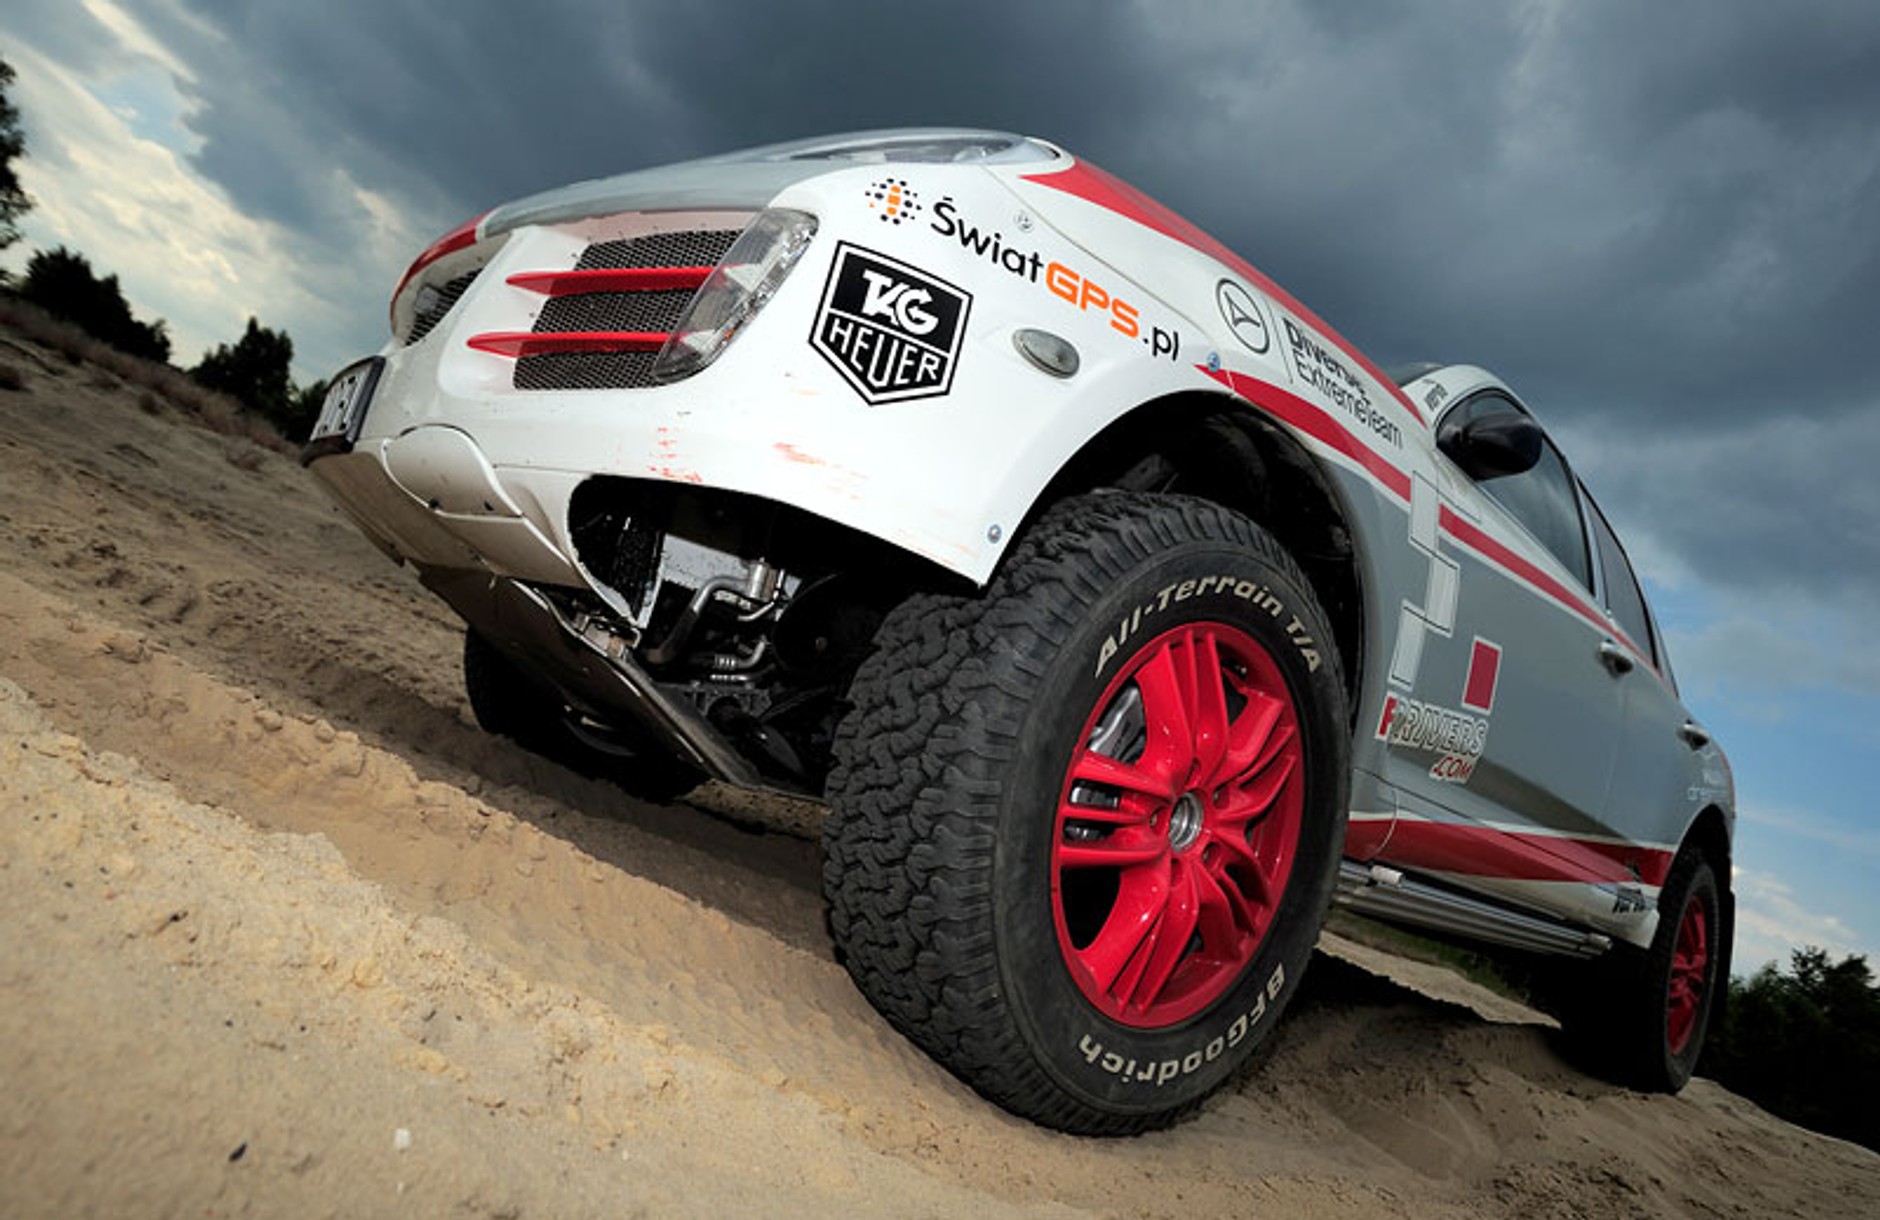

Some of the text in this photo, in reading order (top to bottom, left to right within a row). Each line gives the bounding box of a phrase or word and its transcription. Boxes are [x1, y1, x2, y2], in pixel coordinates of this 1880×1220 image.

[862, 269, 939, 335] TAG
[931, 197, 1180, 360] ŚwiatGPS.pl
[828, 317, 942, 388] HEUER
[1095, 576, 1322, 678] All-Terrain T/A
[1078, 962, 1285, 1086] BFGoodrich
